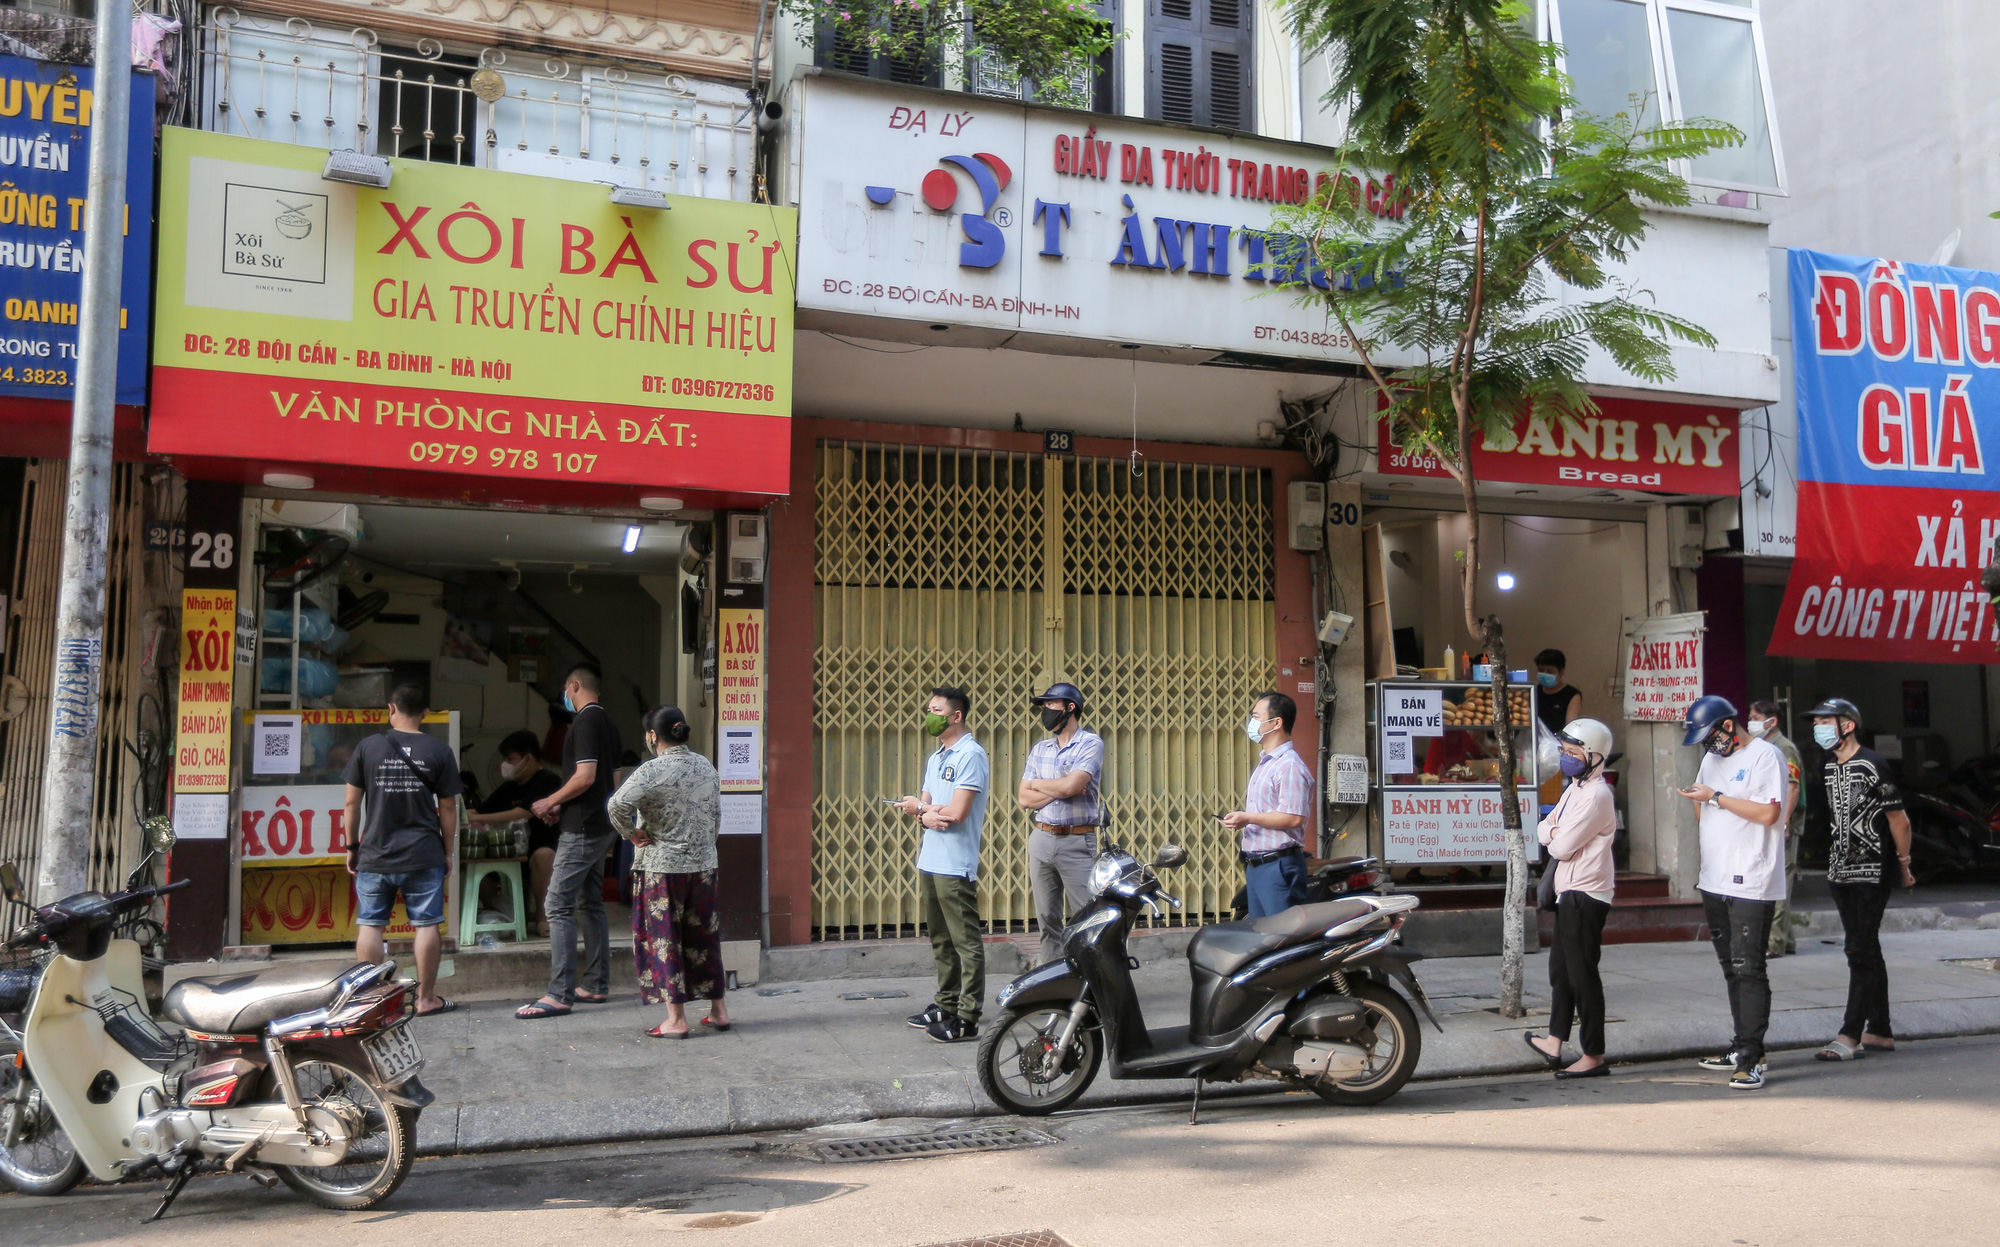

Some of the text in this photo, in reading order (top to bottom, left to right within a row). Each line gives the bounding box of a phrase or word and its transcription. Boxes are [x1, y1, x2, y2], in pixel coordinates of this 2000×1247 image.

[940, 111, 974, 138] LÝ
[1120, 143, 1154, 185] DA
[1162, 146, 1221, 194] THỜI
[1228, 158, 1310, 206] TRANG
[235, 232, 263, 249] Xôi
[377, 201, 781, 295] XÔI BÀ SỬ
[235, 251, 285, 269] Bà Sử
[5, 298, 78, 326] OANH
[373, 278, 777, 358] GIA TRUYỀN CHÍNH HIỆU
[184, 333, 219, 355] ĐC:
[225, 337, 251, 358] 28
[257, 338, 292, 365] ĐỘI
[298, 340, 337, 366] CẤN
[356, 349, 382, 370] BA
[387, 350, 433, 374] ĐÌNH
[451, 356, 475, 378] HÀ
[481, 358, 512, 384] NỘI
[642, 374, 775, 402] ĐT: 0396727336
[270, 390, 698, 449] VĂN PHÒNG NHÀ ĐẤT:
[1857, 373, 1985, 475] GIÁ
[1050, 432, 1069, 450] 28
[1652, 413, 1732, 469] MỲ
[410, 441, 598, 474] 0979 978 107
[1390, 454, 1408, 468] 30
[1412, 455, 1436, 473] Đội
[1558, 466, 1662, 486] Bread
[1329, 502, 1358, 526] 30
[1761, 532, 1773, 543] 30
[1914, 500, 1967, 568] XẢ
[190, 532, 234, 569] 28
[186, 595, 233, 615] Nhận Đặt
[1794, 575, 1990, 652] CÔNG TY VIỆT
[185, 616, 231, 672] XÔI
[723, 612, 760, 654] A XÔI
[726, 656, 739, 670] BÀ
[1629, 632, 1699, 670] BÁNH MỲ
[182, 678, 230, 702] BÁNH CHƯNG
[722, 673, 759, 687] DUY NHẤT
[739, 709, 760, 721] HÀNG
[1401, 696, 1426, 710] BÁN
[181, 711, 206, 734] BÁNH
[1387, 712, 1441, 727] MANG VỀ
[180, 740, 226, 768] GIÒ, CHẢ
[1391, 794, 1442, 815] BÁNH
[1446, 794, 1473, 815] MỲ
[242, 795, 316, 856] XÔI
[1389, 820, 1400, 830] Pa
[1415, 820, 1440, 831] (Pate)
[1390, 834, 1440, 846] Trứng (Egg)
[1452, 834, 1469, 843] Xúc
[1471, 834, 1488, 843] xích
[1436, 849, 1462, 859] (Made
[1463, 848, 1483, 857] from
[1485, 847, 1507, 859] pork)
